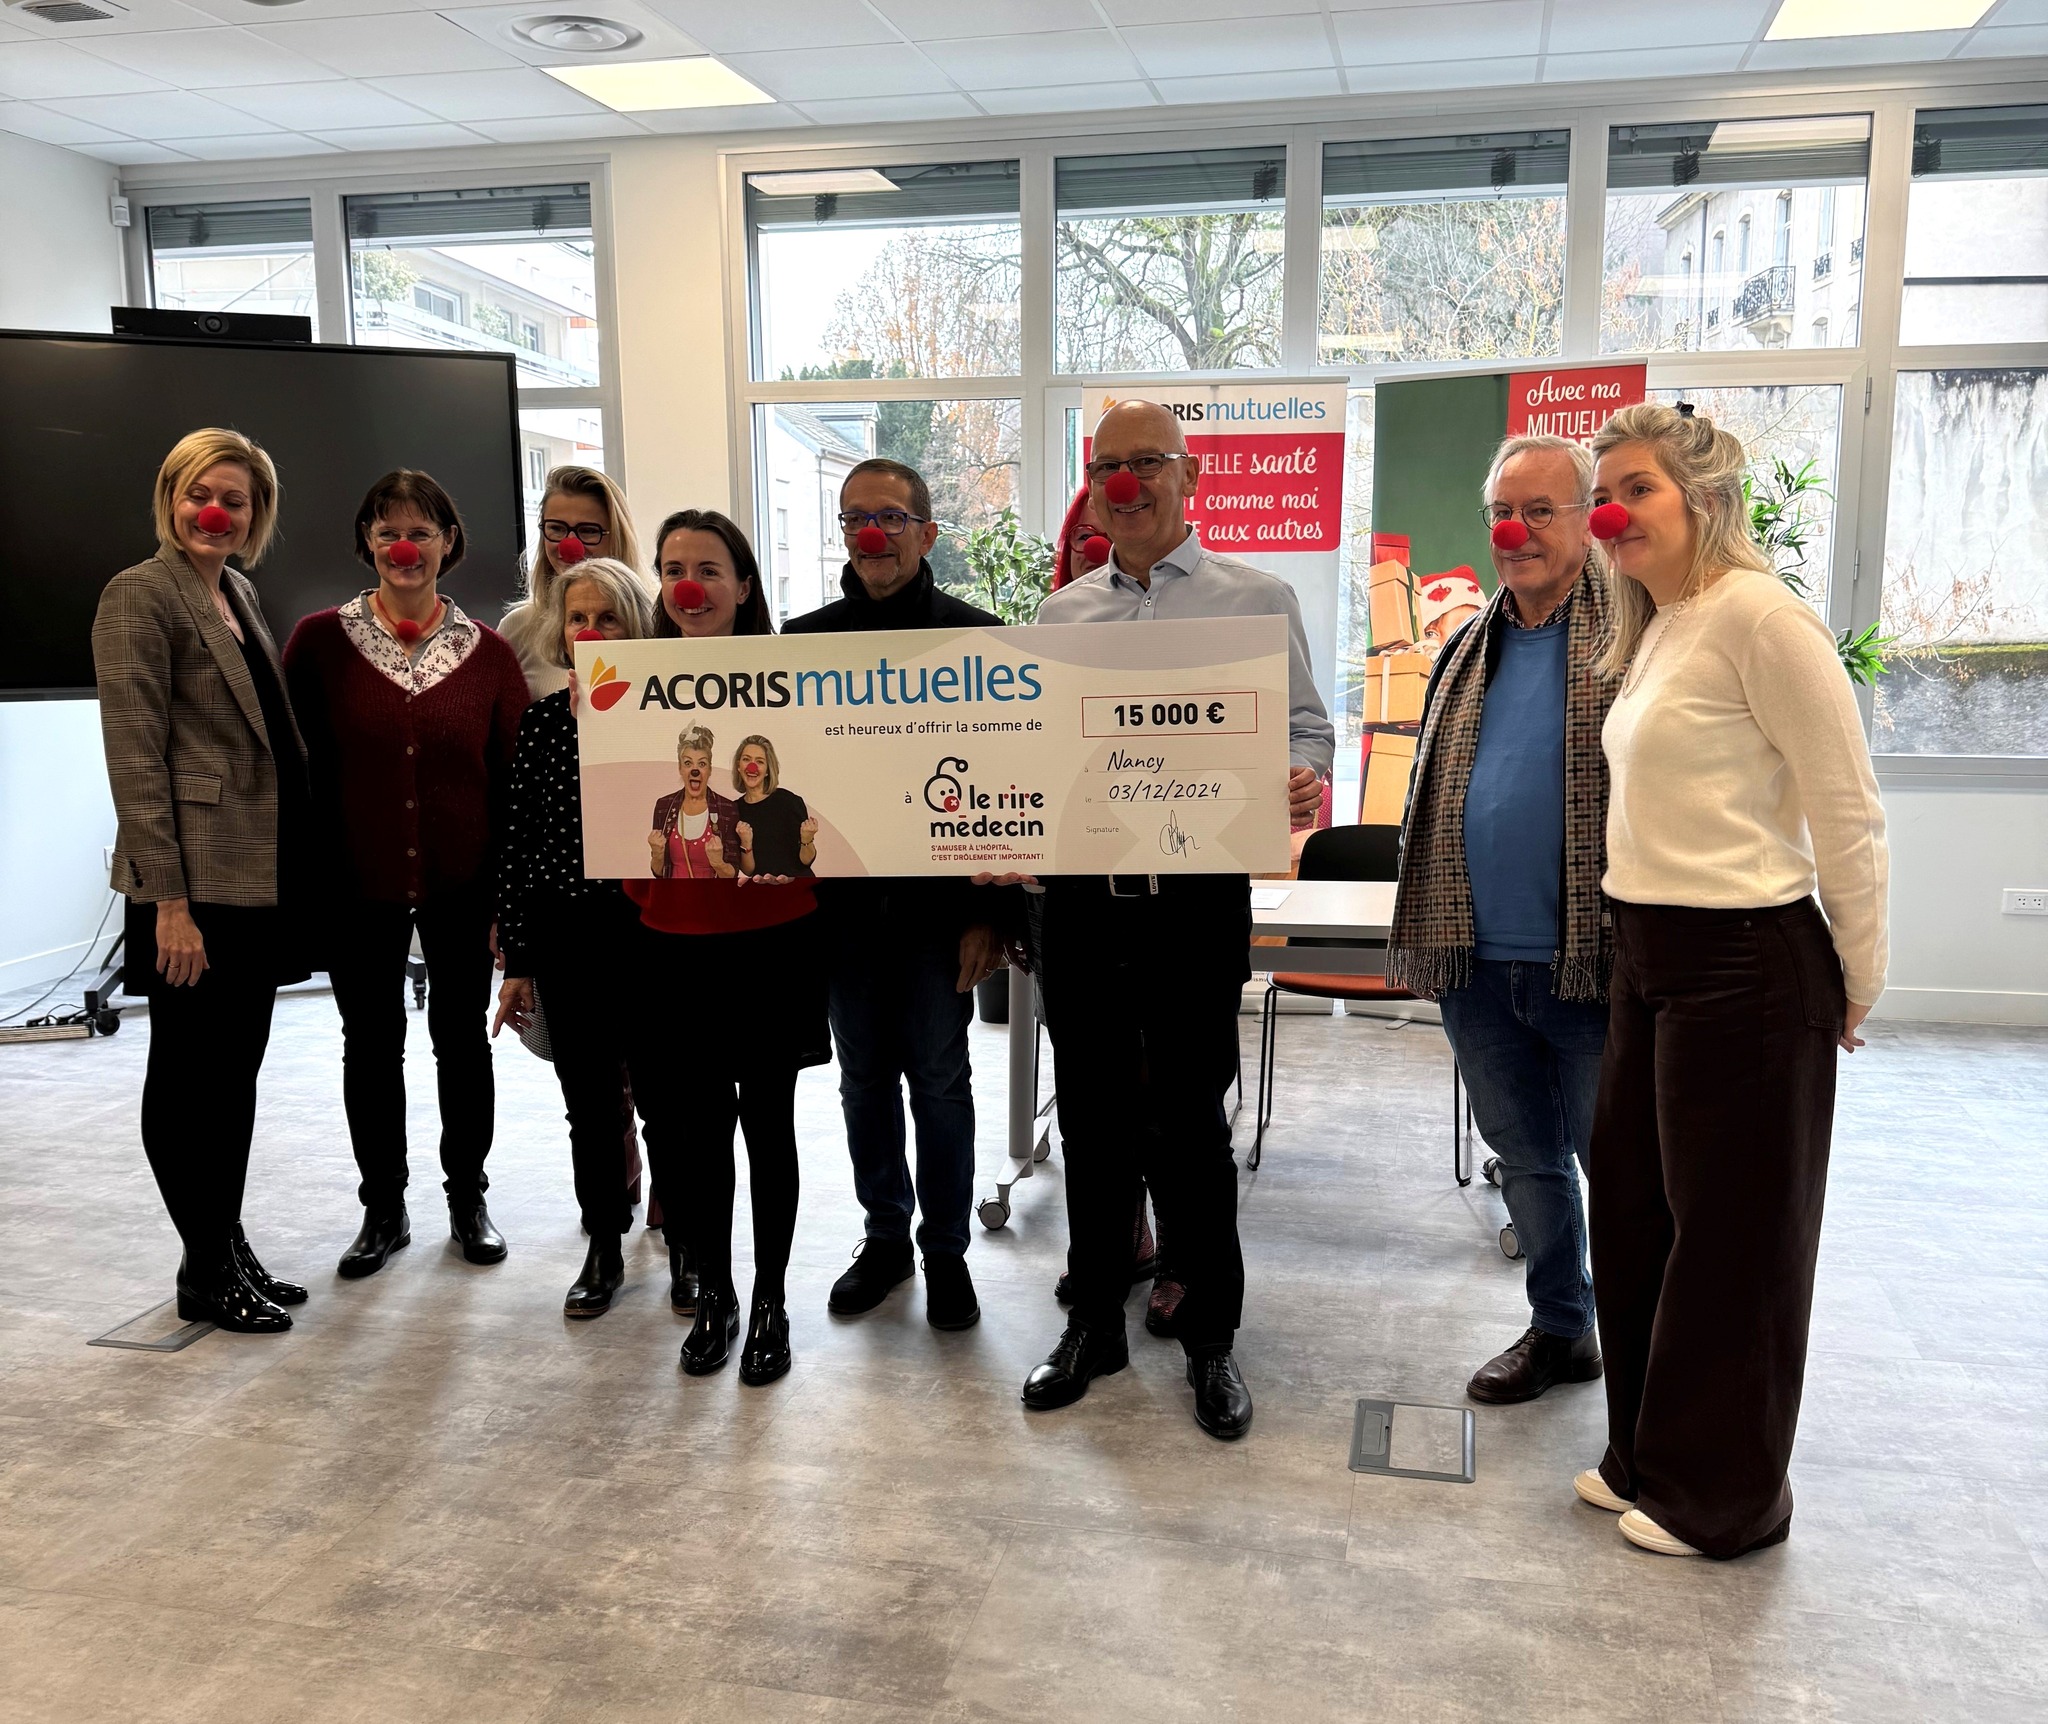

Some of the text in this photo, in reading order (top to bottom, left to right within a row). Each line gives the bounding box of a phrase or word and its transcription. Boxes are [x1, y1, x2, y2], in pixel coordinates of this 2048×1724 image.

[1526, 375, 1621, 406] Avec ma
[1250, 446, 1317, 475] santé
[1205, 493, 1274, 511] comme
[1281, 487, 1319, 510] moi
[1208, 523, 1250, 542] aux
[1256, 519, 1323, 540] autres
[1114, 702, 1225, 727] 15 000 €
[824, 725, 844, 736] est
[848, 723, 902, 736] heureux
[956, 720, 968, 733] la
[972, 722, 1022, 733] somme
[1026, 719, 1042, 731] de
[1107, 749, 1165, 773] Nancy
[904, 784, 1044, 810] à le rire
[1108, 779, 1222, 803] 03/12/2024
[1085, 826, 1119, 834] Signature
[953, 852, 997, 861] DRÔLEMENT
[968, 843, 975, 851] À
